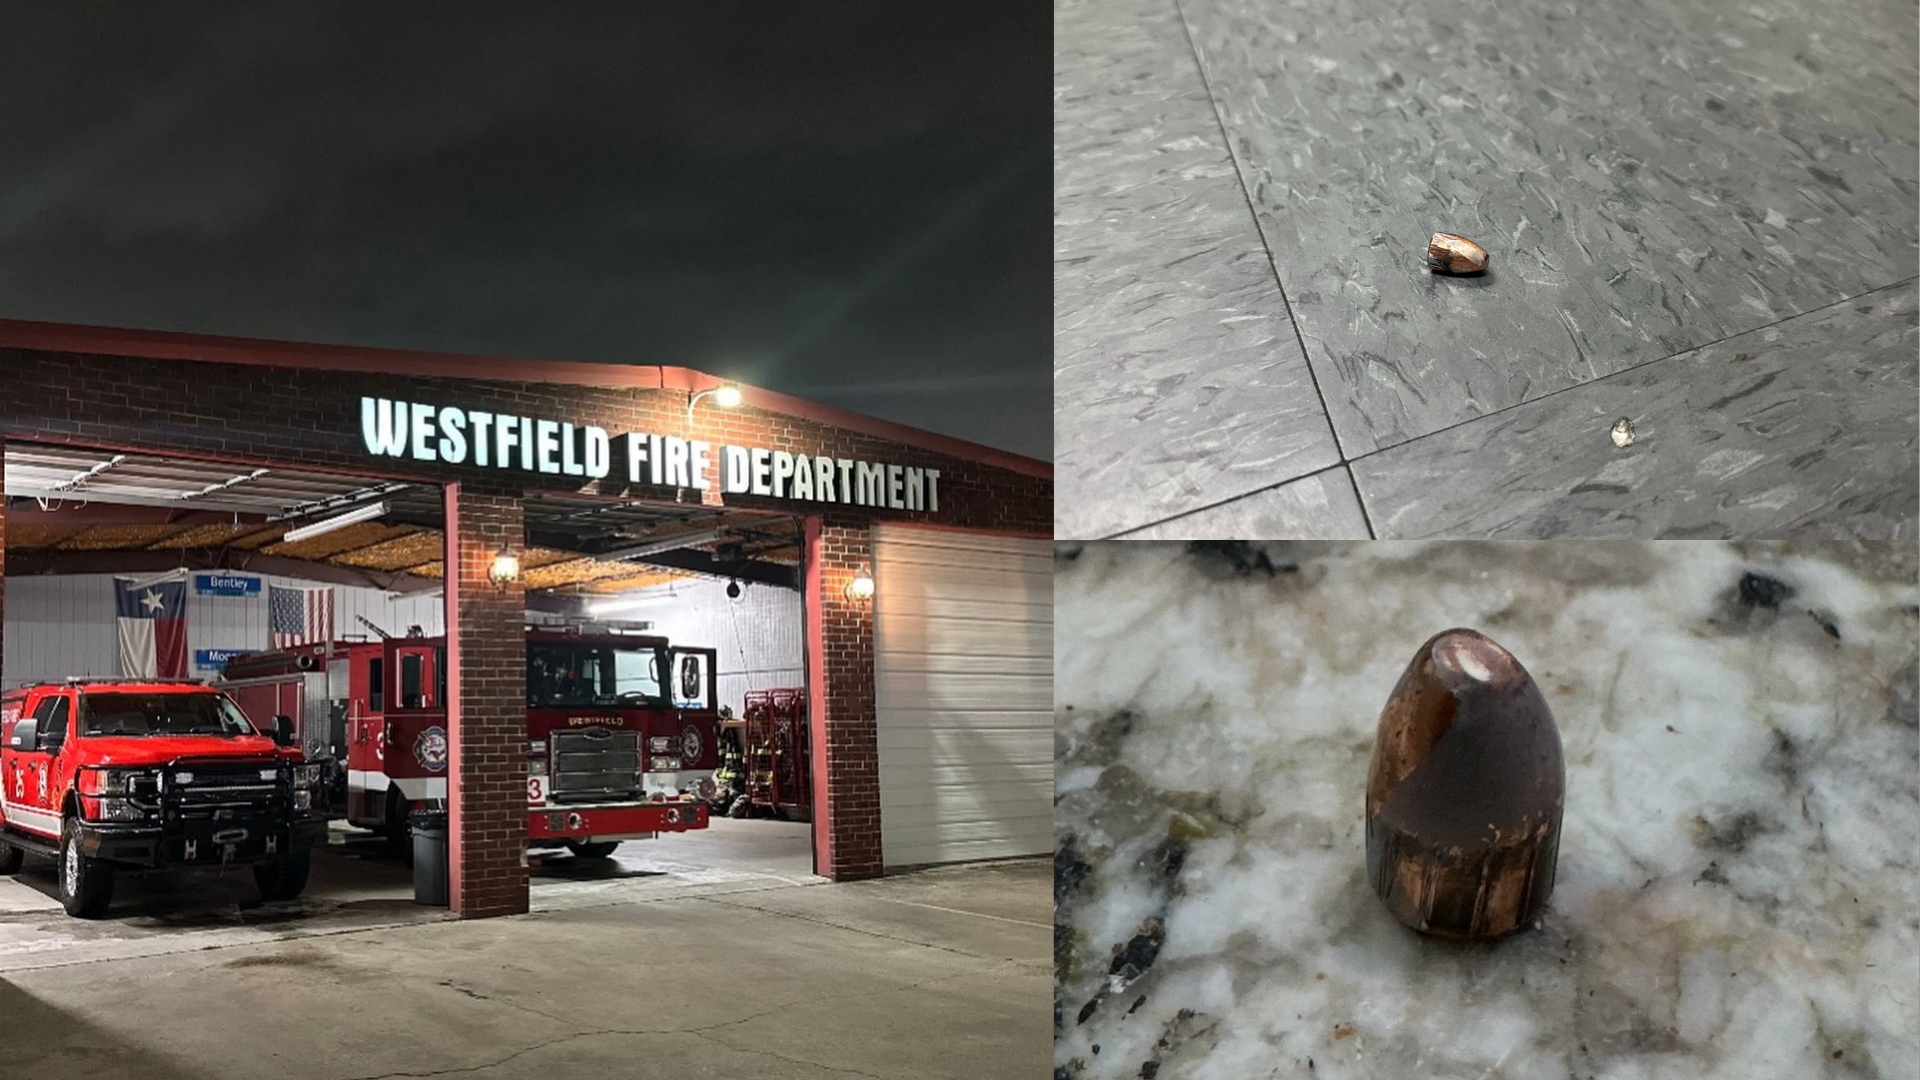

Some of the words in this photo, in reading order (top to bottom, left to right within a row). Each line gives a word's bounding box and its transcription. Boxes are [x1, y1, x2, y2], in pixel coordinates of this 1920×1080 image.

[361, 396, 611, 479] WESTFIELD
[626, 432, 711, 490] FIRE
[726, 444, 941, 512] DEPARTMENT
[210, 576, 248, 591] Bentley
[568, 716, 624, 727] WESTFIELD
[527, 778, 542, 800] 3
